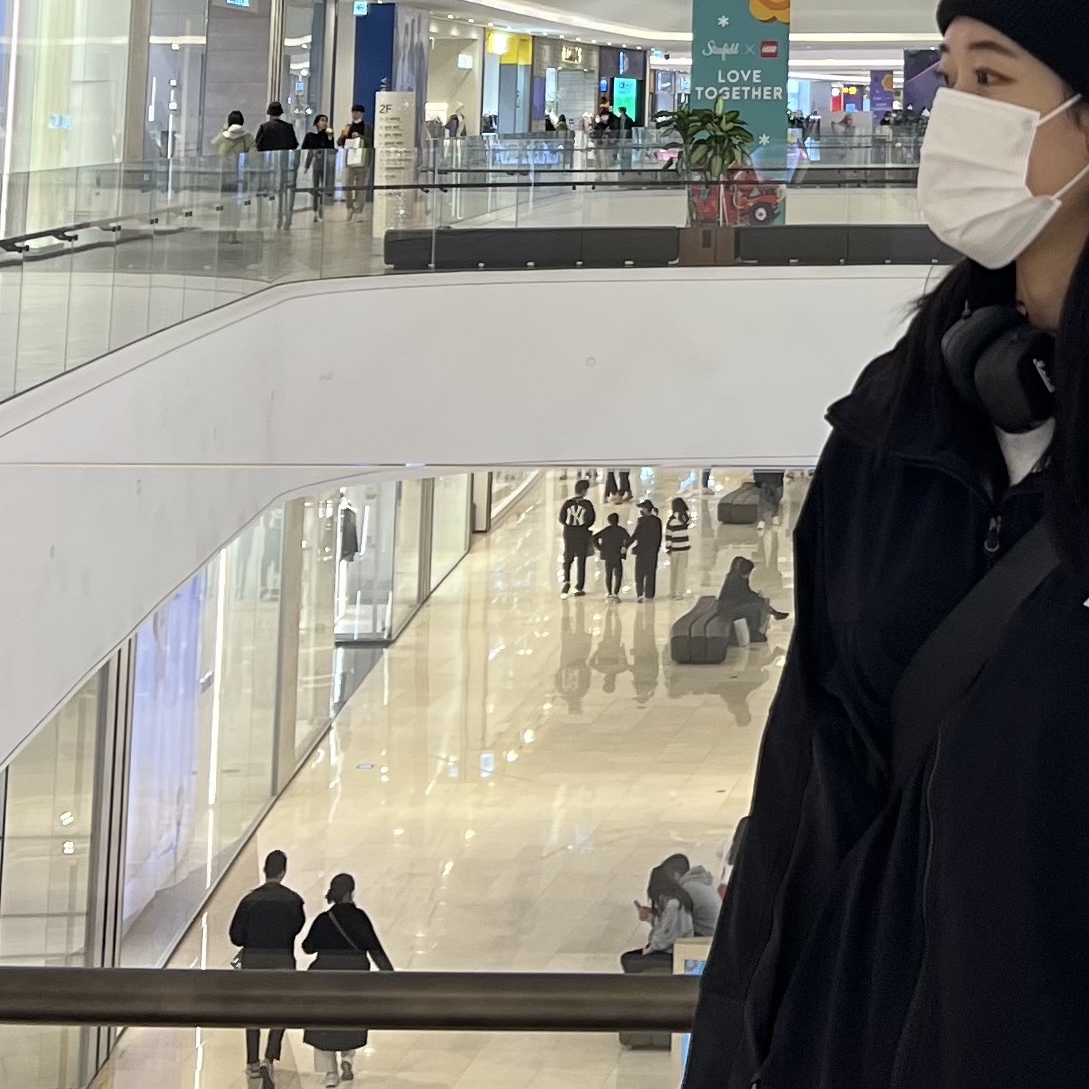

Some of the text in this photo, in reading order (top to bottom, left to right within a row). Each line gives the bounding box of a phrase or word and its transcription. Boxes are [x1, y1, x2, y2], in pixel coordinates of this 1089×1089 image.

[718, 69, 762, 83] LOVE
[694, 86, 783, 100] TOGETHER
[378, 104, 392, 114] 2F
